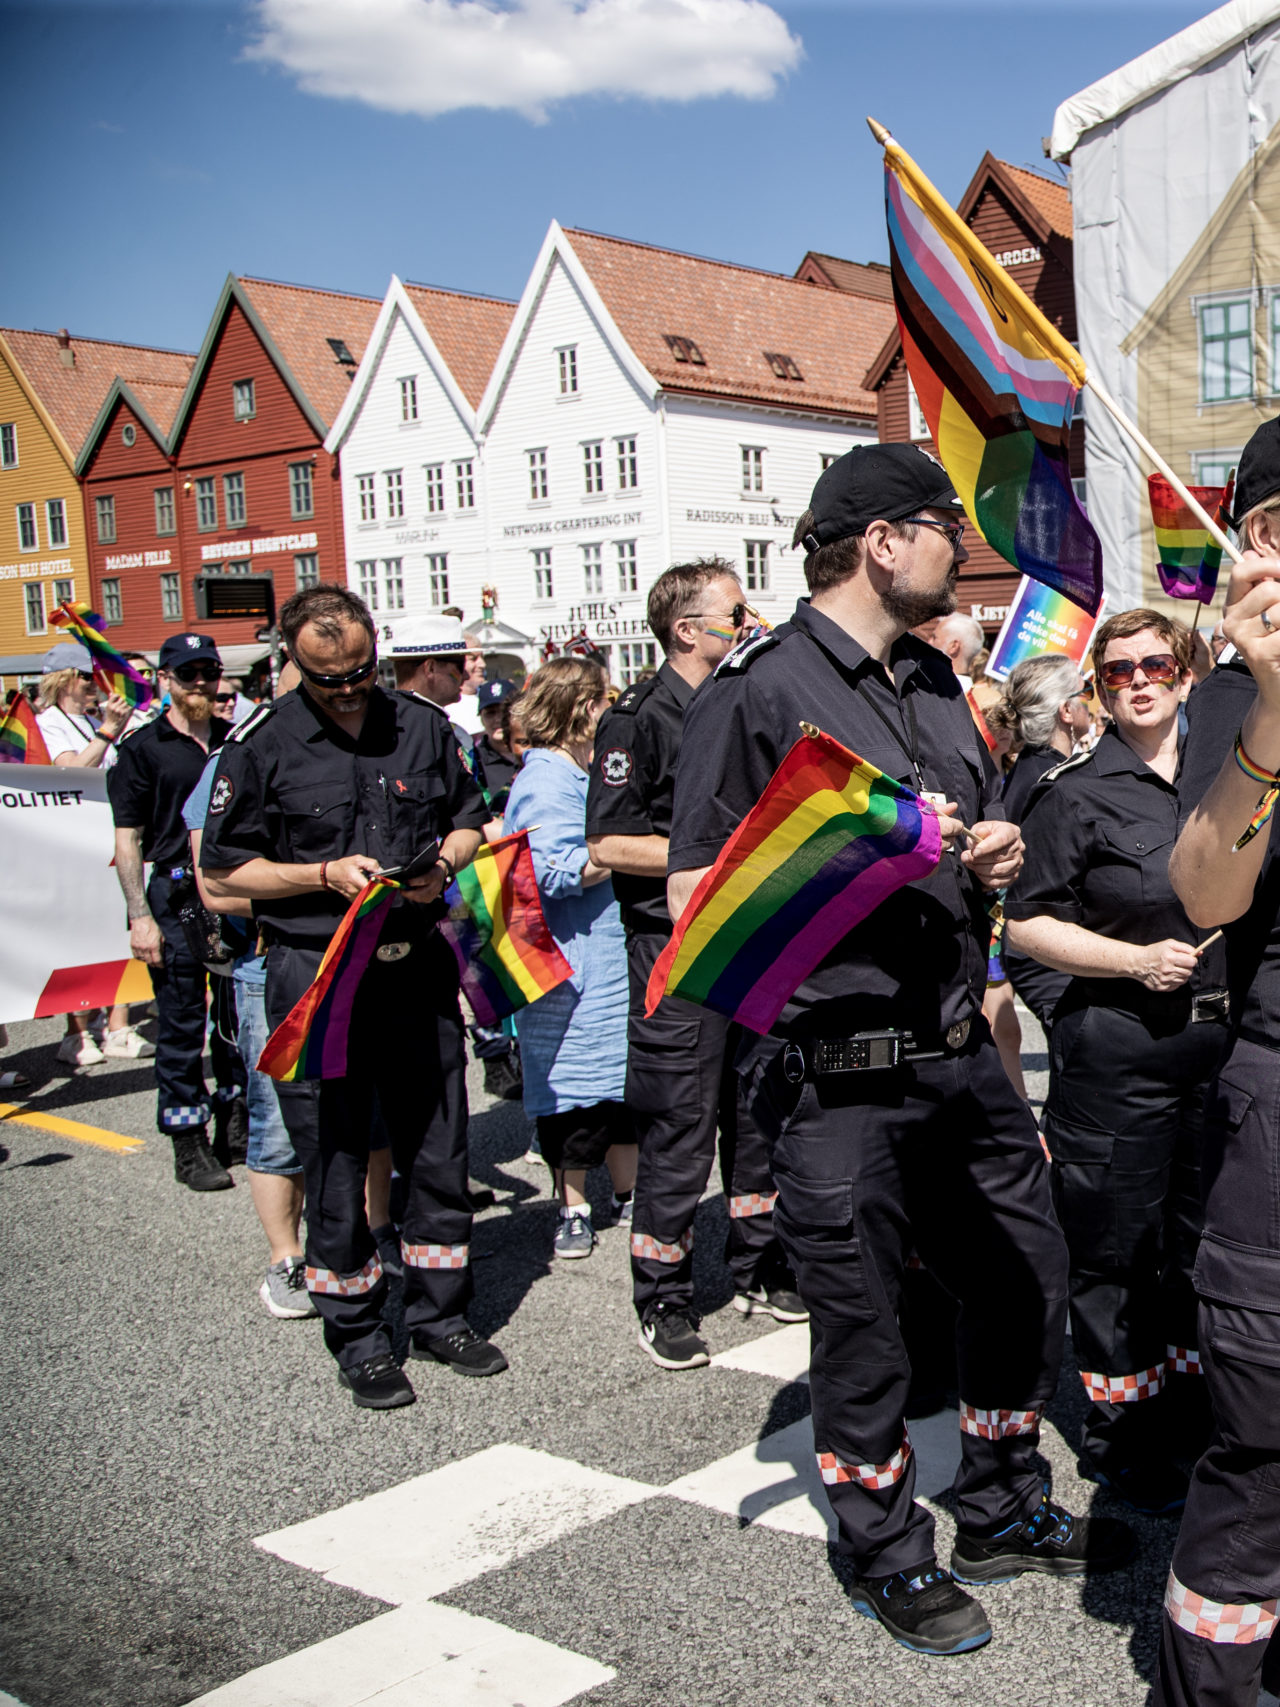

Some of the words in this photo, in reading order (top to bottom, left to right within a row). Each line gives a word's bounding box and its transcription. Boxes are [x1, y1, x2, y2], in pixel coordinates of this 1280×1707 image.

[503, 521, 552, 536] NETWORK
[554, 514, 621, 531] CHARTERING
[686, 509, 743, 524] RADISSON
[749, 513, 769, 526] BLU
[201, 540, 251, 560] BRYGGEN
[252, 532, 319, 554] NIGHTCLUB
[40, 558, 75, 576] HOTEL
[105, 552, 143, 570] MADAM
[1026, 609, 1047, 625] Alle
[1046, 619, 1068, 634] skal
[1017, 630, 1032, 642] de
[1022, 621, 1049, 638] elske
[1048, 632, 1067, 647] den
[0, 789, 84, 809] OLITIET
